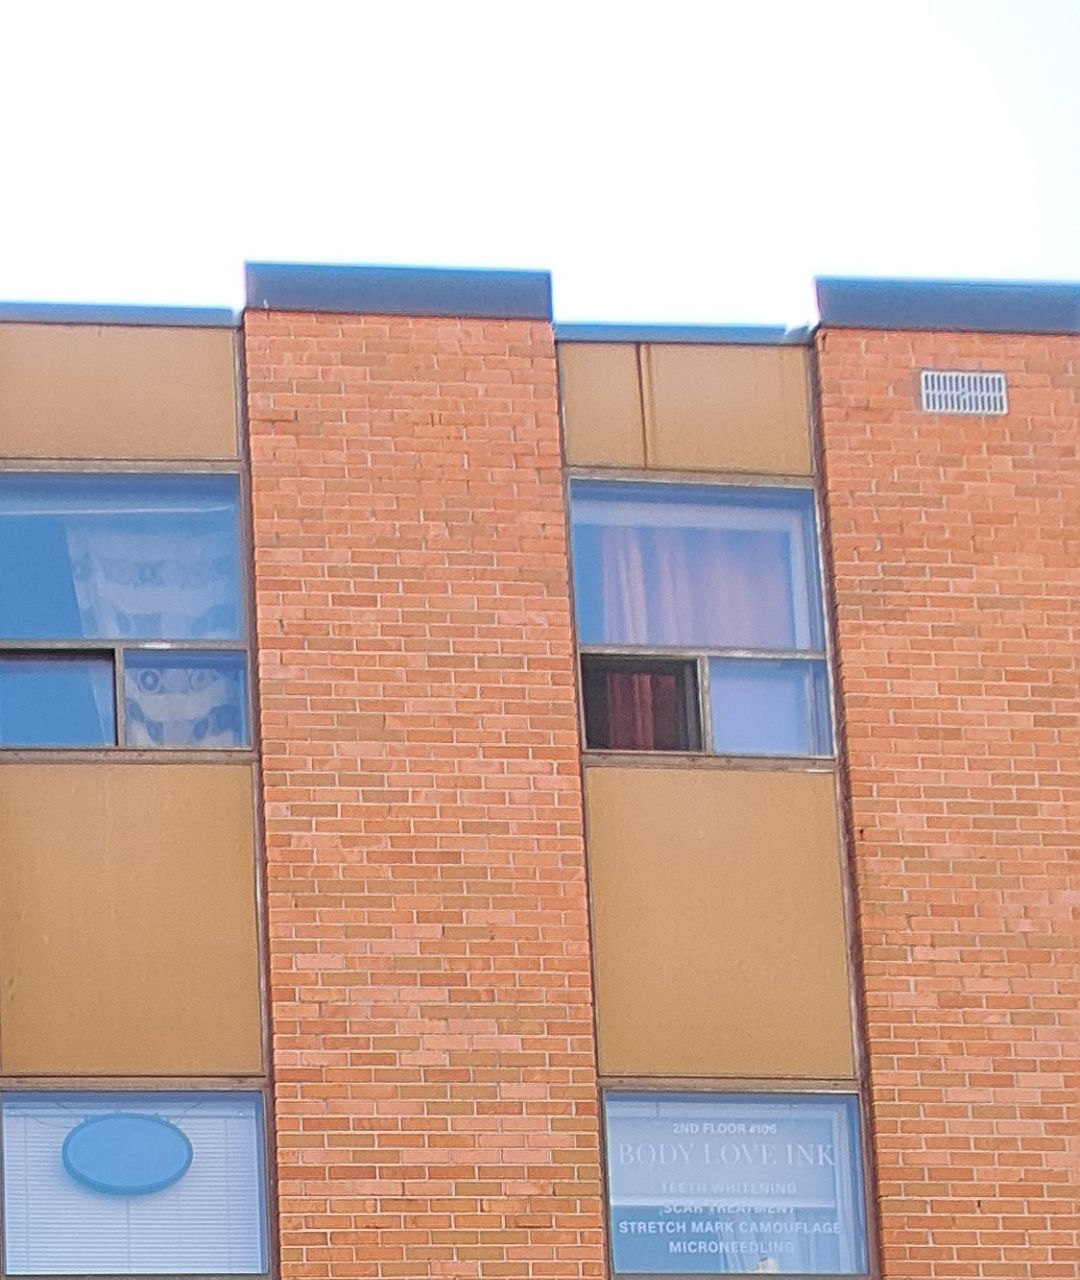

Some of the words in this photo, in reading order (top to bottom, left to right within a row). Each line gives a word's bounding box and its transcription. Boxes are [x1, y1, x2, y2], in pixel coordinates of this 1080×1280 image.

[672, 1123, 699, 1134] 2ND
[703, 1123, 746, 1134] FLOOR
[620, 1143, 695, 1165] BODY
[703, 1143, 777, 1166] LOVE
[786, 1143, 836, 1166] INK
[710, 1182, 798, 1195] WHITENING
[618, 1221, 687, 1234] STRETCH
[691, 1221, 735, 1233] MARK
[738, 1221, 842, 1234] CAMOUFLAGE
[669, 1241, 795, 1253] MICRONEEDLING
